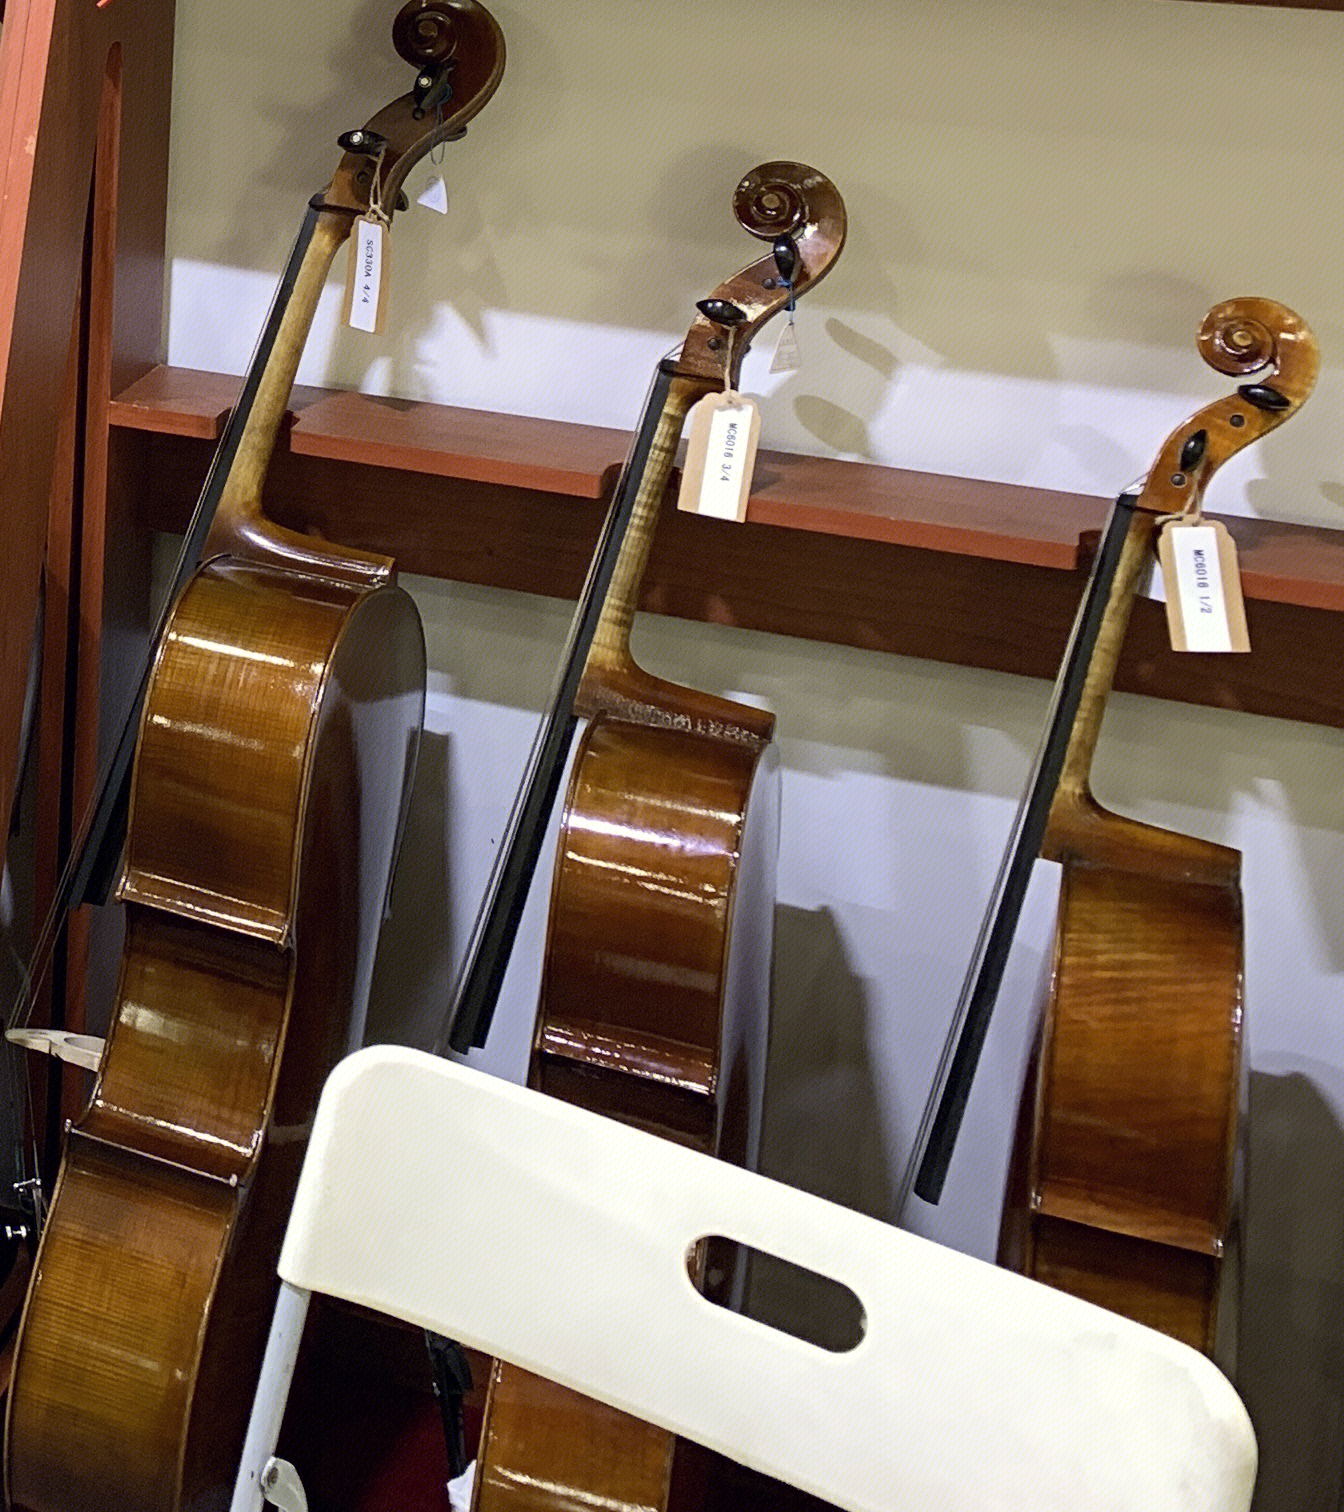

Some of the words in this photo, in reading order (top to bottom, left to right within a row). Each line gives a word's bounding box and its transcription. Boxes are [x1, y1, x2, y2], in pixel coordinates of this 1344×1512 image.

[364, 239, 374, 278] SC330A
[361, 284, 371, 304] 4/4
[719, 463, 732, 482] 3/4
[1199, 595, 1213, 614] 1/2
